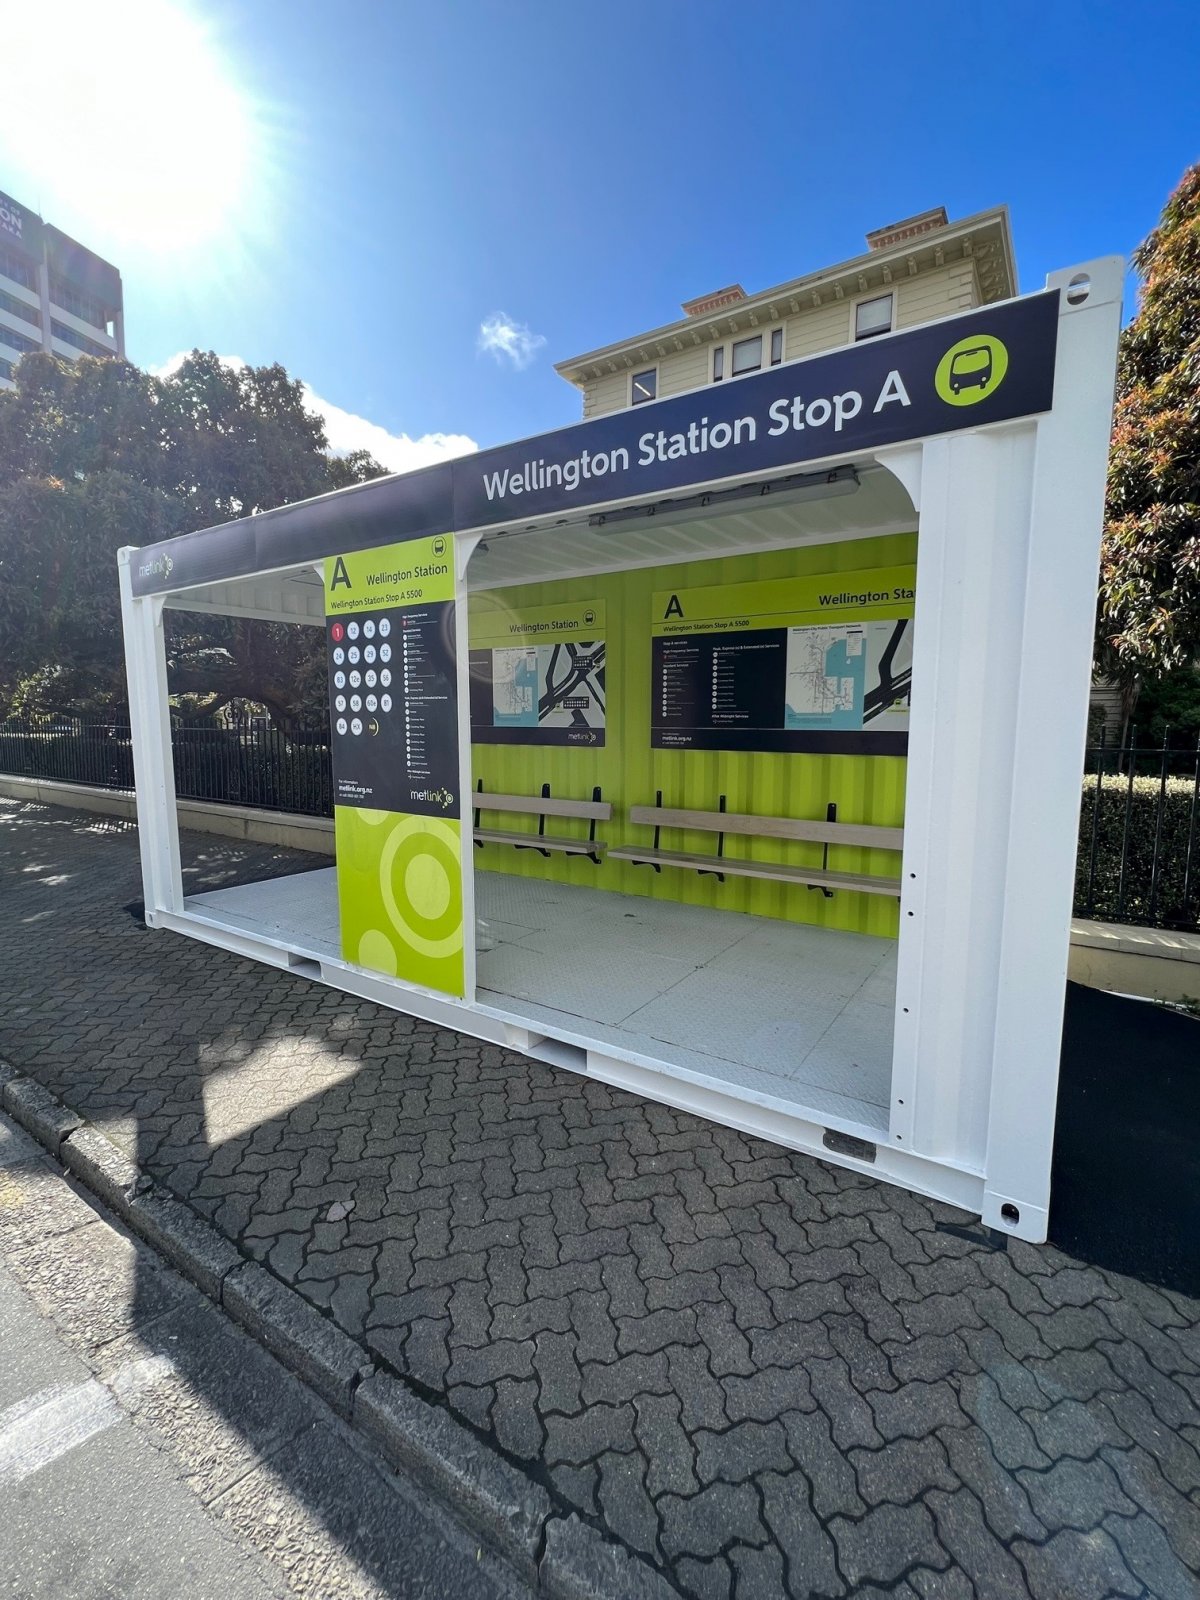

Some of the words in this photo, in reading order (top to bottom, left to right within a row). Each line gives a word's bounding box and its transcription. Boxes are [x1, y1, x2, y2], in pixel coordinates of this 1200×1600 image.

[483, 447, 629, 500] Wellington
[638, 416, 757, 466] Station
[767, 389, 862, 436] Stop
[872, 369, 912, 413] A
[330, 556, 352, 591] A
[366, 569, 412, 586] Wellington
[414, 563, 448, 578] Station
[330, 599, 363, 610] Wellington
[364, 596, 385, 606] Station
[386, 592, 400, 603] Stop
[406, 589, 423, 599] 5500
[819, 591, 889, 606] Wellington
[893, 587, 916, 600] Sta
[663, 594, 684, 619] A
[509, 623, 550, 633] Wellington
[551, 620, 579, 629] Station
[663, 625, 692, 633] Wellington
[714, 622, 728, 630] Stop
[382, 649, 389, 657] 52
[336, 676, 344, 684] 83
[350, 675, 360, 683] 12e
[367, 674, 375, 682] 35
[382, 674, 389, 682] 56
[366, 699, 377, 707] 60e
[338, 784, 373, 795] metlink.org.nz
[410, 789, 443, 803] metlink
